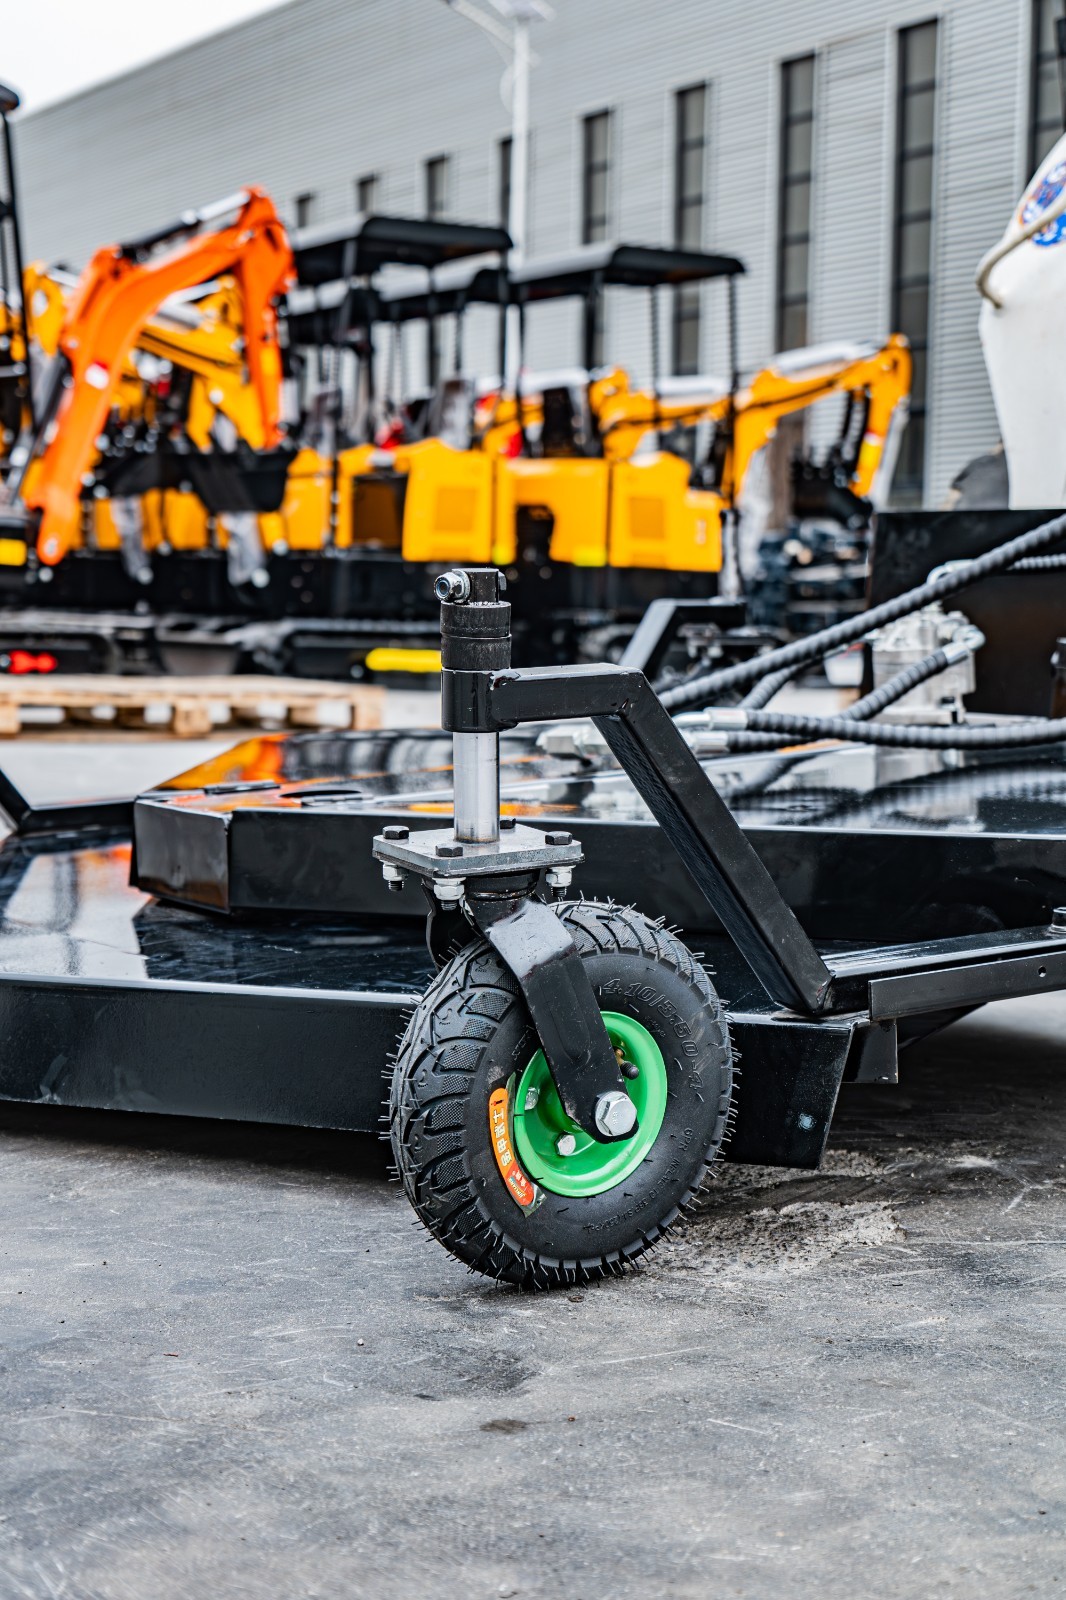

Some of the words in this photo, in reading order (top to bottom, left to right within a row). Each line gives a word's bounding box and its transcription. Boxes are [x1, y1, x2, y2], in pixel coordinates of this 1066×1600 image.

[493, 1108, 512, 1167] 金甲武士
[679, 1127, 694, 1152] 6PR
[658, 1158, 680, 1189] INFLATE
[648, 1188, 658, 1199] TO
